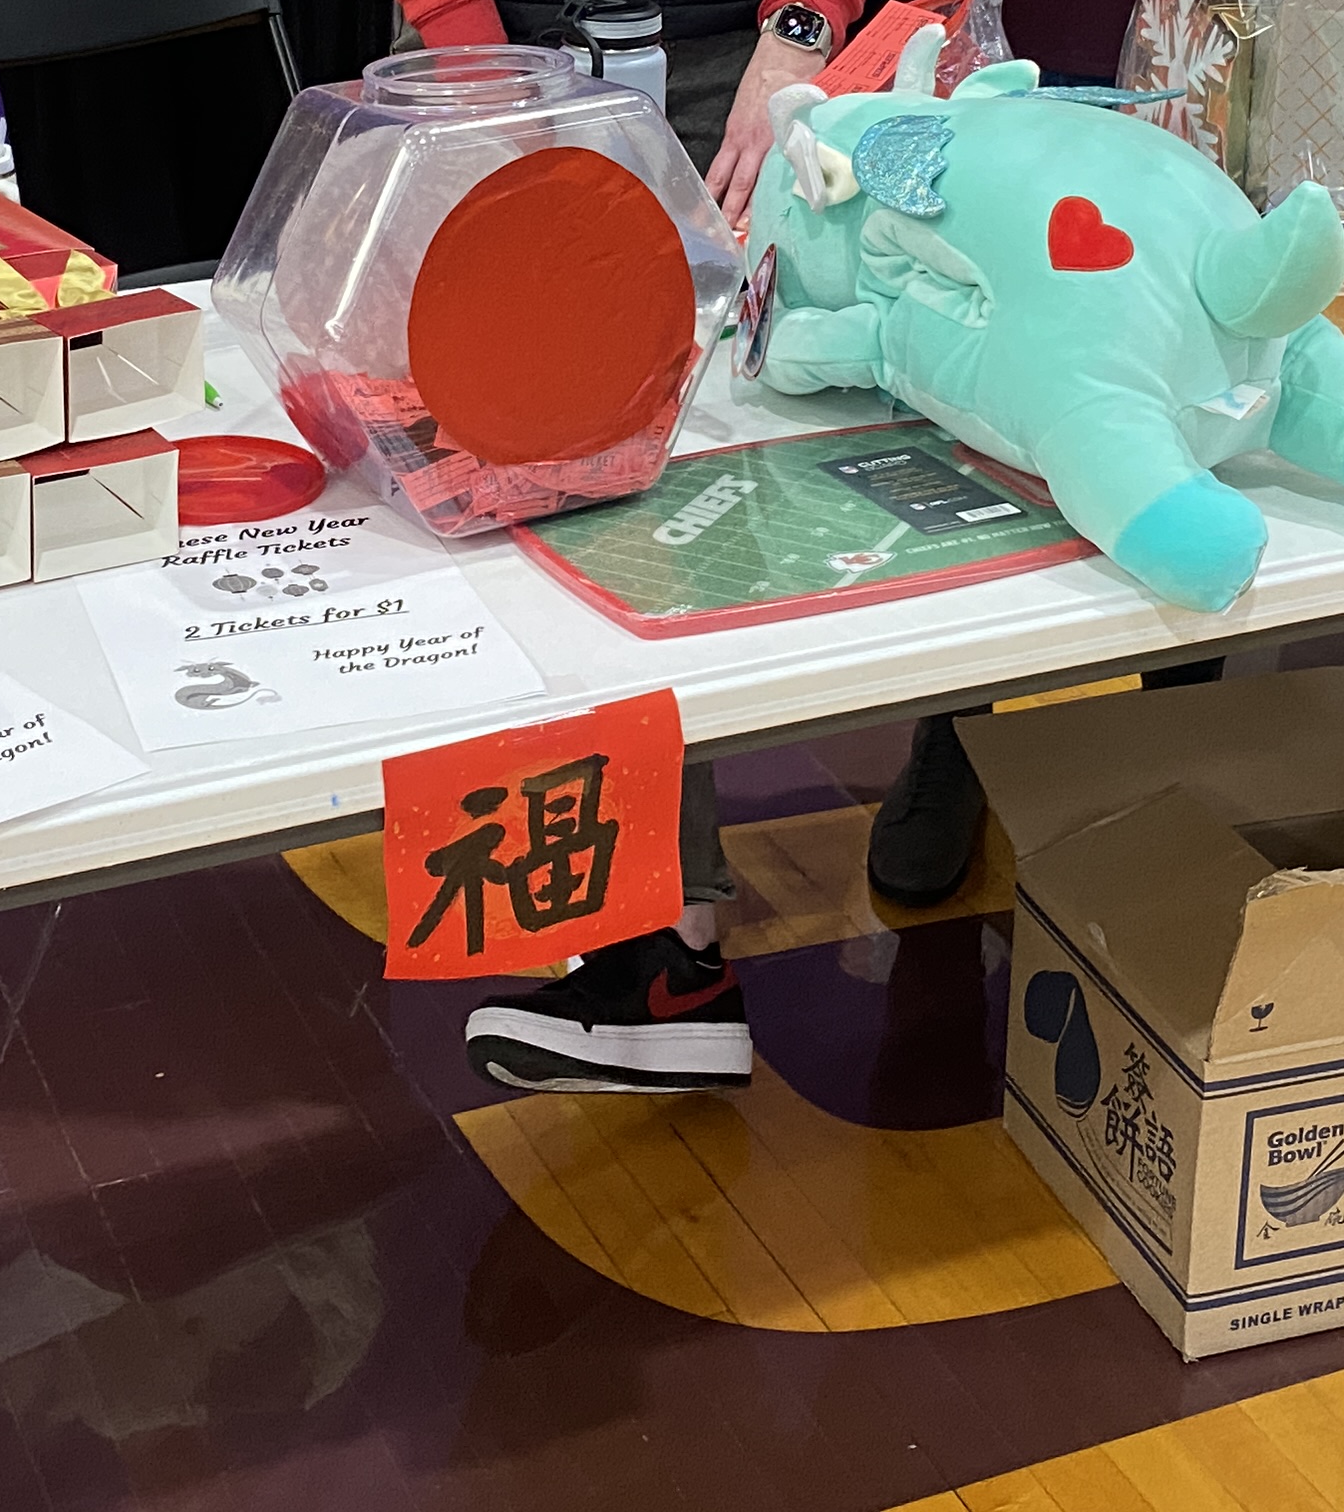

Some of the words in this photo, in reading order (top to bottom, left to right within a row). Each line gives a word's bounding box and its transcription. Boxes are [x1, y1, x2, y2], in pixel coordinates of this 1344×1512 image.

[857, 453, 912, 469] CUTTING
[652, 473, 759, 545] CHIEFS
[239, 524, 298, 542] New
[308, 514, 371, 536] Year
[161, 548, 248, 569] Raffle
[258, 534, 352, 557] Tickets
[184, 625, 201, 641] 2
[211, 611, 311, 637] Tickets
[323, 605, 366, 624] for
[377, 598, 405, 616] $1
[312, 642, 390, 663] Happy
[399, 631, 452, 652] Year
[461, 626, 485, 642] of
[339, 659, 376, 675] the
[384, 643, 480, 670] Dragon!
[22, 712, 48, 736] of
[407, 752, 619, 956] 福
[1267, 1123, 1344, 1149] Golden
[1268, 1141, 1323, 1166] Bowl
[1229, 1306, 1293, 1331] SINGLE
